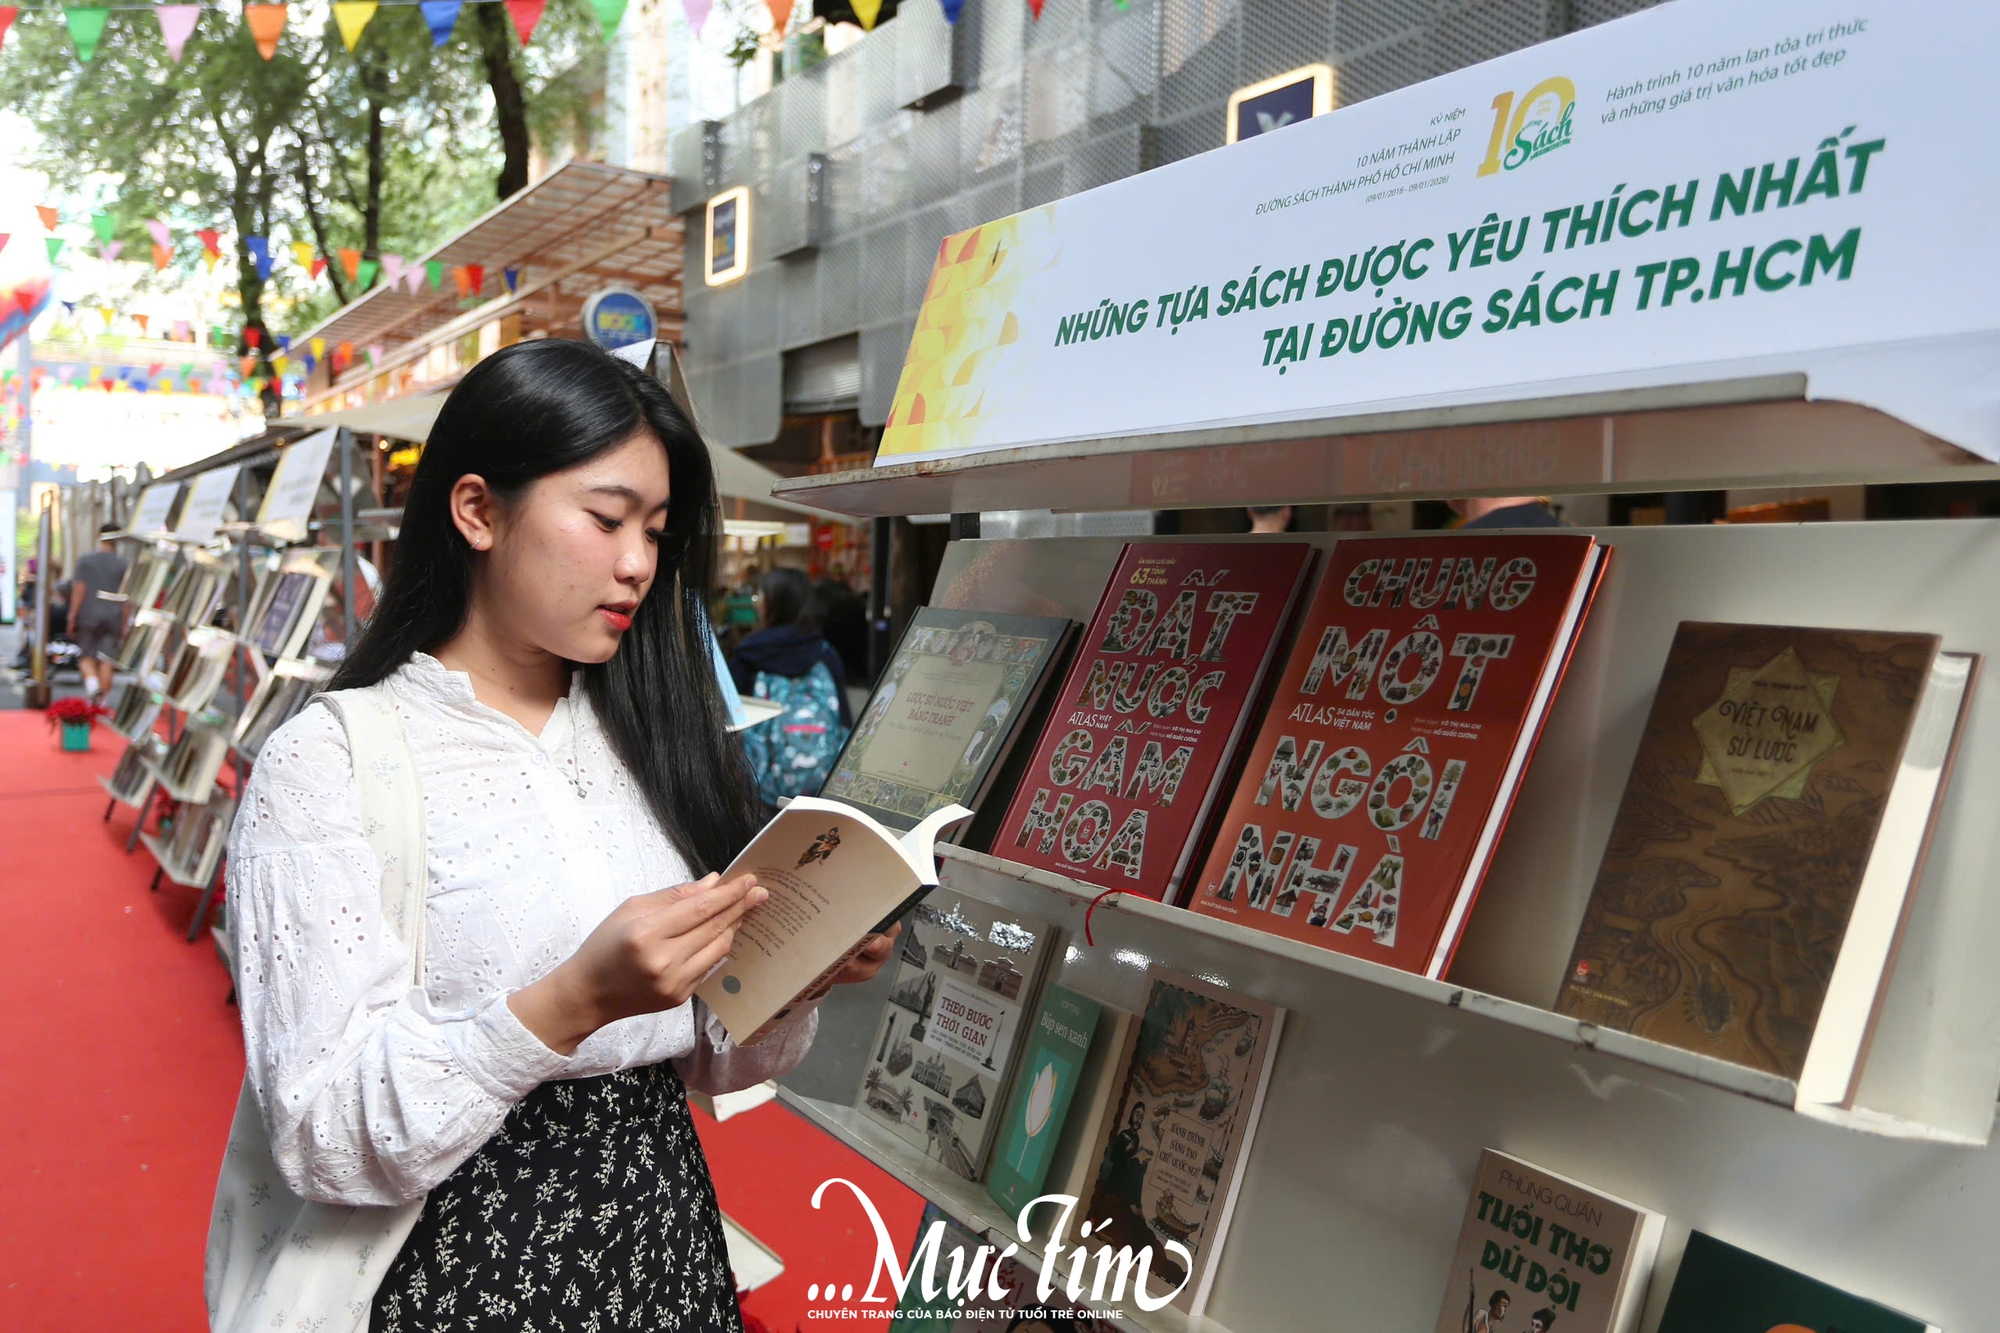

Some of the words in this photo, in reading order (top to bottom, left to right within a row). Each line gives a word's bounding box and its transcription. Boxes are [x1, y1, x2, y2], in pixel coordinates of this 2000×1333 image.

[1601, 109, 1616, 124] và
[1619, 94, 1666, 120] những
[1669, 87, 1692, 111] giá
[1696, 82, 1712, 101] trị
[1717, 75, 1744, 93] văn
[1748, 66, 1779, 86] hóa
[1783, 57, 1807, 76] tốt
[1811, 48, 1847, 70] đẹp
[1606, 82, 1642, 102] Hành
[1647, 70, 1681, 91] trình
[1686, 64, 1704, 80] 10
[1706, 55, 1741, 75] năm
[1745, 47, 1770, 64] lan
[1774, 37, 1801, 55] tỏa
[1805, 29, 1823, 48] tri
[1828, 18, 1868, 41] thức
[1444, 108, 1466, 125] NIỆM
[1503, 101, 1574, 171] Sách
[1355, 154, 1369, 168] 10
[1369, 147, 1396, 166] NĂM
[1398, 136, 1437, 157] THÀNH
[1438, 127, 1462, 148] LẬP
[1255, 197, 1292, 215] ĐƯỜNG
[1293, 187, 1319, 206] SÁCH
[1321, 178, 1356, 200] THÀNH
[1357, 166, 1382, 188] PHỐ
[1382, 164, 1401, 182] HỒ
[1402, 156, 1422, 177] CHÍ
[1423, 151, 1456, 173] MINH
[1366, 186, 1404, 204] (09/01/2016
[1054, 298, 1149, 347] NHỮNG
[1156, 285, 1209, 335] TỰA
[1216, 265, 1311, 316] SÁCH
[1315, 238, 1435, 297] ĐƯỢC
[1448, 212, 1530, 272] YÊU
[1542, 182, 1700, 255] THÍCH
[1708, 125, 1886, 222] NHẤT
[1262, 323, 1315, 376] TẠI
[1319, 296, 1473, 358] ĐƯỜNG
[1481, 270, 1620, 334] SÁCH
[1634, 227, 1862, 312] TP.HCM
[1129, 567, 1151, 585] 63
[1344, 557, 1538, 611] CHUNG
[1099, 569, 1260, 663] ĐẤT
[1075, 654, 1226, 724] NƯỚC
[1299, 614, 1515, 724] MỘT
[1067, 711, 1098, 728] ATLAS
[1098, 714, 1113, 723] VIỆT
[1096, 722, 1109, 730] NAM
[1288, 703, 1336, 726] ATLAS
[1336, 707, 1346, 716] 54
[1345, 708, 1361, 718] DÂN
[1333, 717, 1351, 730] VIỆT
[1352, 720, 1372, 731] NAM
[1719, 700, 1768, 730] VIỆT
[1771, 705, 1819, 740] NAM
[1727, 731, 1753, 757] SỬ
[1049, 718, 1194, 808] GẤM
[1253, 735, 1467, 841] NGÔI
[1014, 787, 1149, 880] HOA
[1216, 821, 1404, 948] NHÀ
[936, 1013, 960, 1034] THỜI
[962, 1026, 988, 1047] GIAN
[941, 996, 966, 1017] THEO
[966, 1008, 994, 1030] BƯỚC
[1041, 1011, 1055, 1035] Búp
[1054, 1022, 1069, 1039] sen
[1068, 1029, 1088, 1049] xanh
[1499, 1169, 1553, 1204] PHÙNG
[1555, 1193, 1603, 1227] QUÁN
[1477, 1190, 1544, 1246] TUỔI
[1548, 1222, 1613, 1275] THƠ
[1480, 1239, 1527, 1284] DỮ
[1525, 1261, 1581, 1313] DỘI
